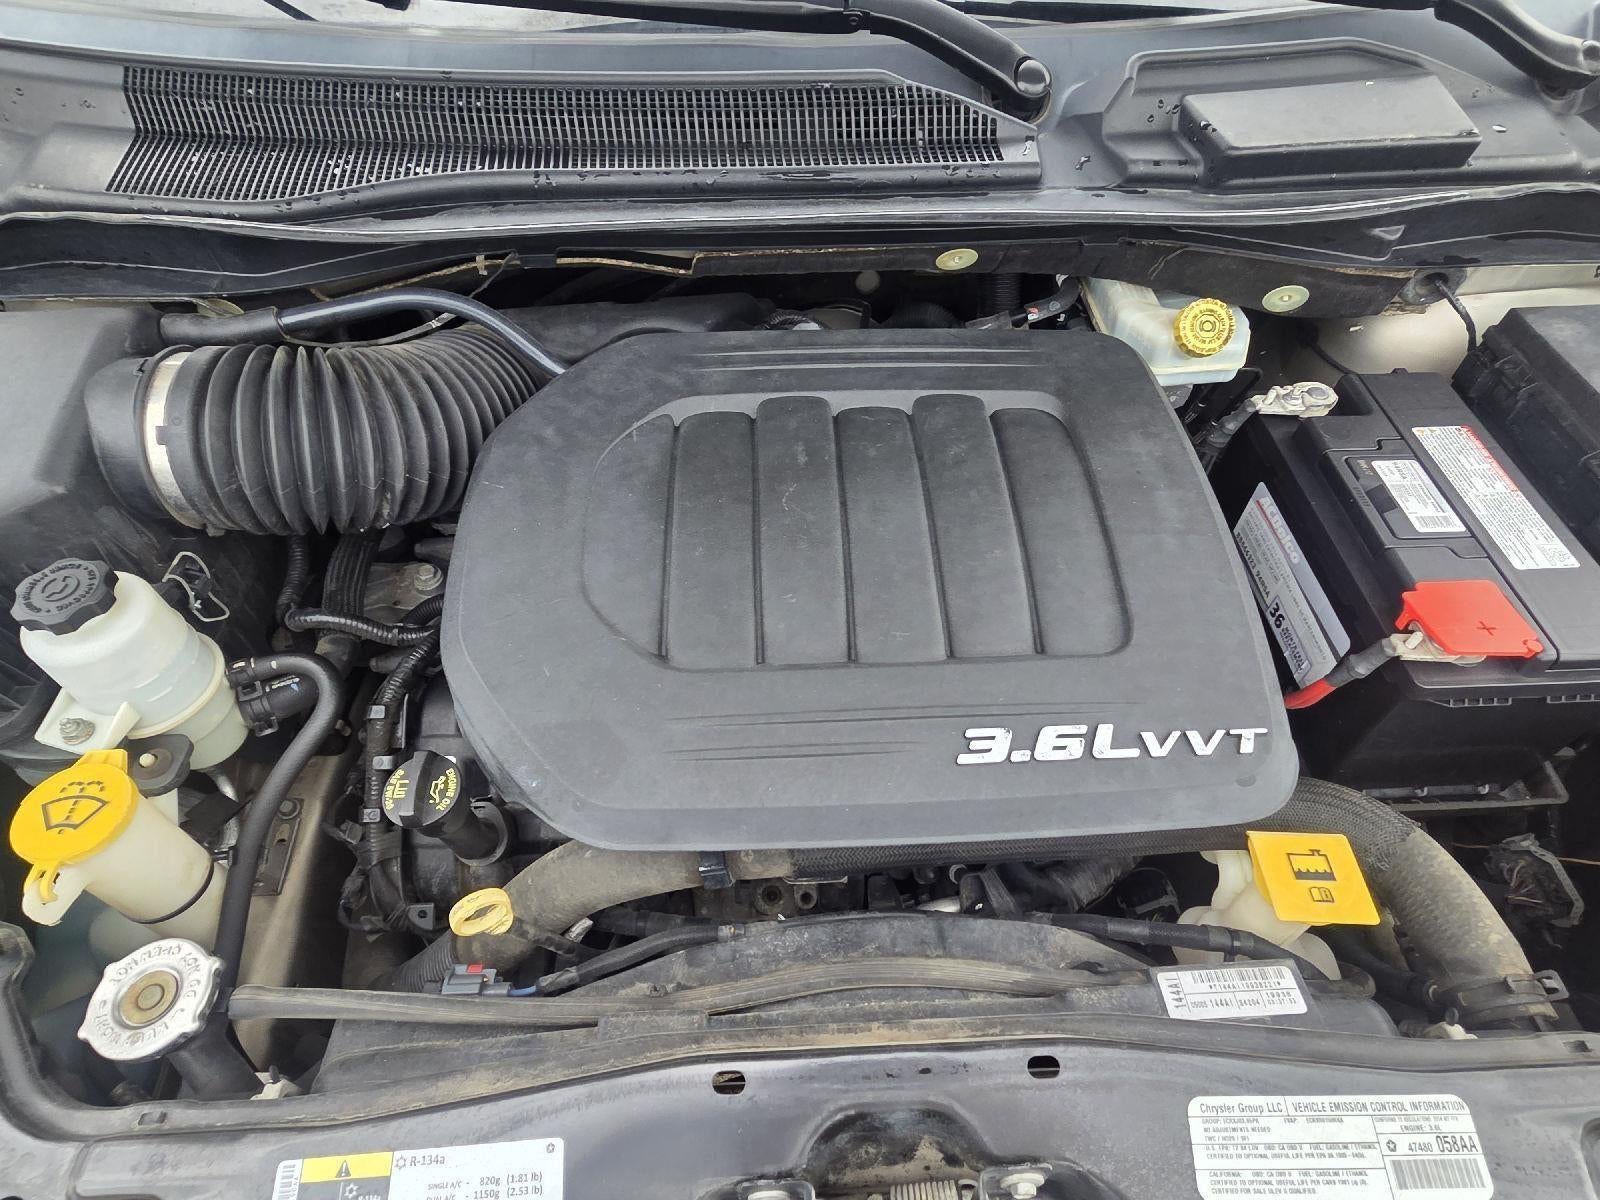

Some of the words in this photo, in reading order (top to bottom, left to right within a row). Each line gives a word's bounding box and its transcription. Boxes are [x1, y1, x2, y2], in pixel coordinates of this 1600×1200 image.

[1270, 602, 1285, 628] 36
[957, 723, 1141, 765] 3.6L
[1140, 727, 1269, 758] VVT
[390, 769, 405, 785] SAE
[446, 768, 457, 798] ENGINE
[435, 798, 451, 811] OIL
[1200, 1103, 1235, 1115] Chrysler
[1238, 1102, 1264, 1114] Group
[1266, 1102, 1283, 1113] LLC
[1292, 1101, 1327, 1112] VEHICLE
[1329, 1101, 1369, 1112] EMISSION
[1370, 1101, 1408, 1112] CONTROL
[1410, 1100, 1466, 1112] INFORMATION
[1435, 1135, 1479, 1153] 058AA
[409, 1154, 446, 1167] R-134a
[427, 1181, 449, 1191] SINGLE
[450, 1179, 463, 1190] A/C
[480, 1176, 501, 1187] 820g
[507, 1173, 529, 1185] (1.81
[531, 1171, 543, 1183] lb)
[474, 1189, 500, 1200] 1150g
[507, 1186, 529, 1198] (2.53
[531, 1184, 543, 1196] lb)
